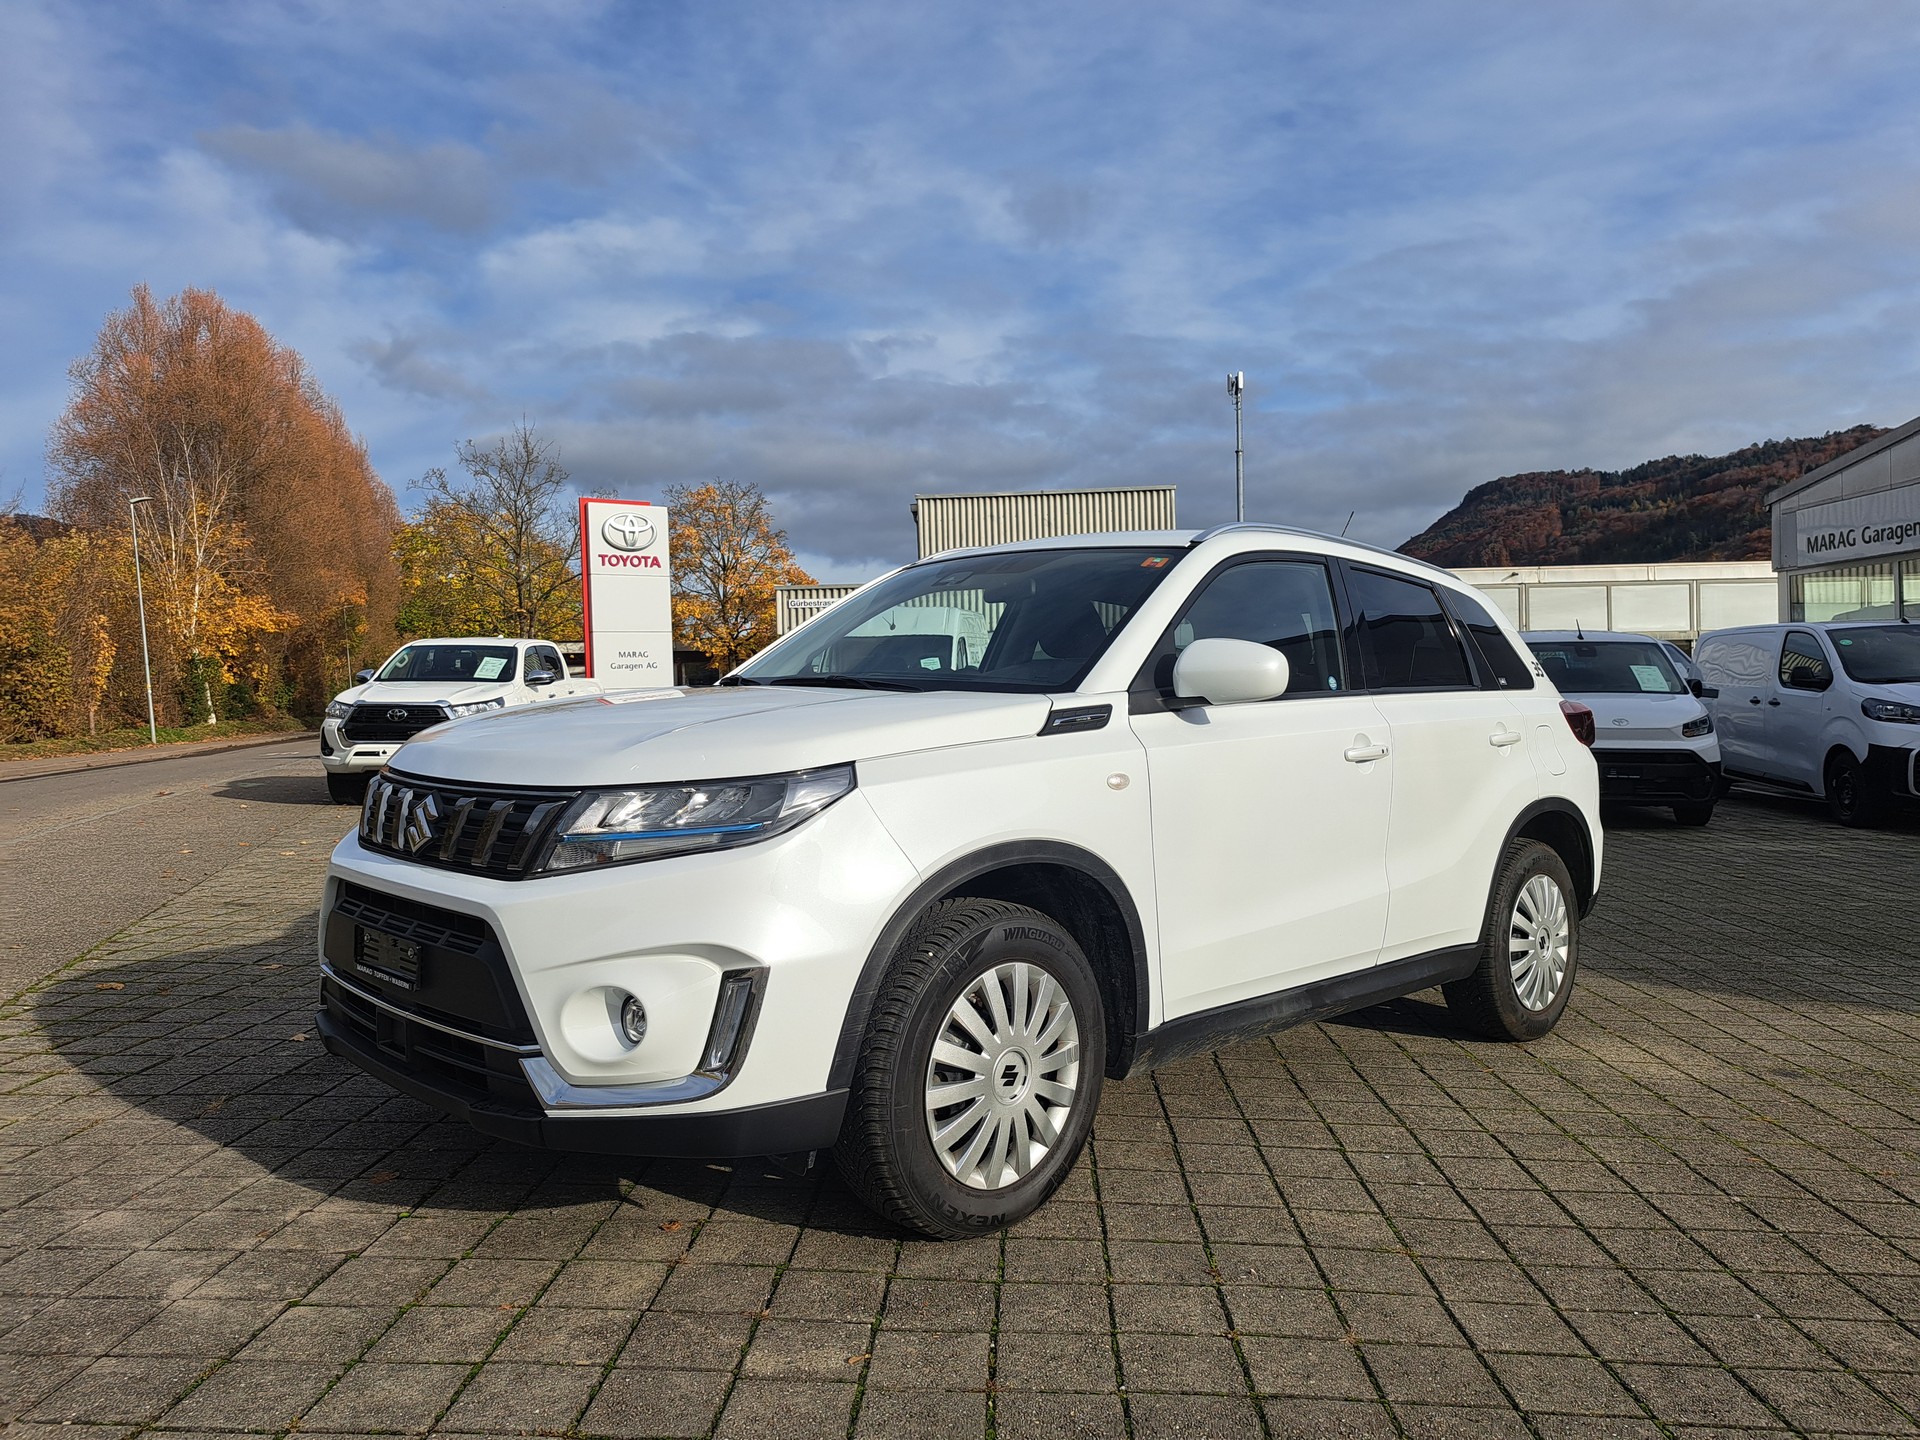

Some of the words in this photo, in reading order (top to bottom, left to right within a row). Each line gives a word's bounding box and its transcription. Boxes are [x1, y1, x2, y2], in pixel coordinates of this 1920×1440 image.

[1807, 529, 1856, 554] MARAG
[1861, 522, 1920, 545] Garagen
[598, 554, 661, 569] TOYOTA
[618, 651, 649, 659] MARAG
[610, 662, 643, 671] Garagen
[1003, 927, 1064, 951] WINGUARD
[929, 1192, 1006, 1226] NEXEN
